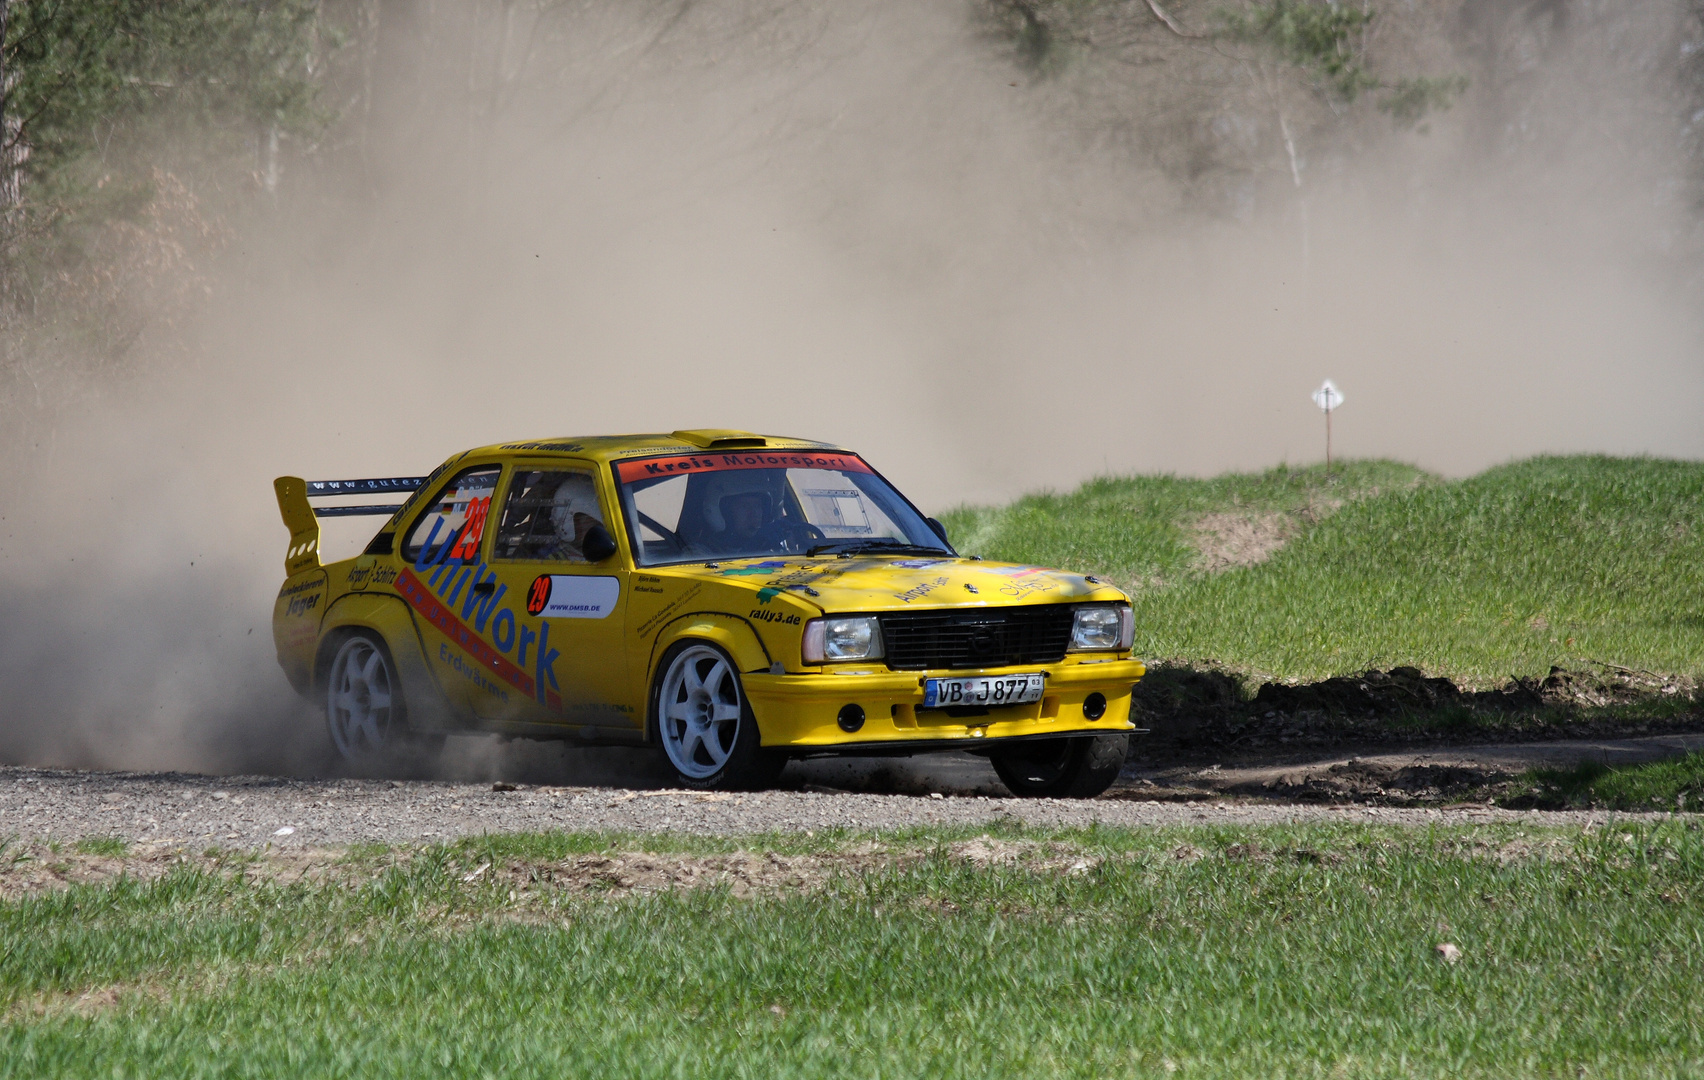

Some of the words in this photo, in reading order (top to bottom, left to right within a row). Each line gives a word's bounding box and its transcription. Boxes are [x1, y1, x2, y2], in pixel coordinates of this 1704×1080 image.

[644, 458, 714, 475] Kreis
[722, 454, 847, 468] Motorsport
[449, 496, 491, 560] 29
[286, 593, 321, 617] Jäger
[527, 576, 550, 612] 29
[414, 515, 560, 705] UniWork
[550, 604, 600, 612] WWW.DMSB.DE
[749, 608, 801, 625] rally3.de
[439, 642, 509, 705] Erdwärme
[938, 682, 962, 702] VB
[976, 681, 990, 701] J
[994, 679, 1028, 700] 877
